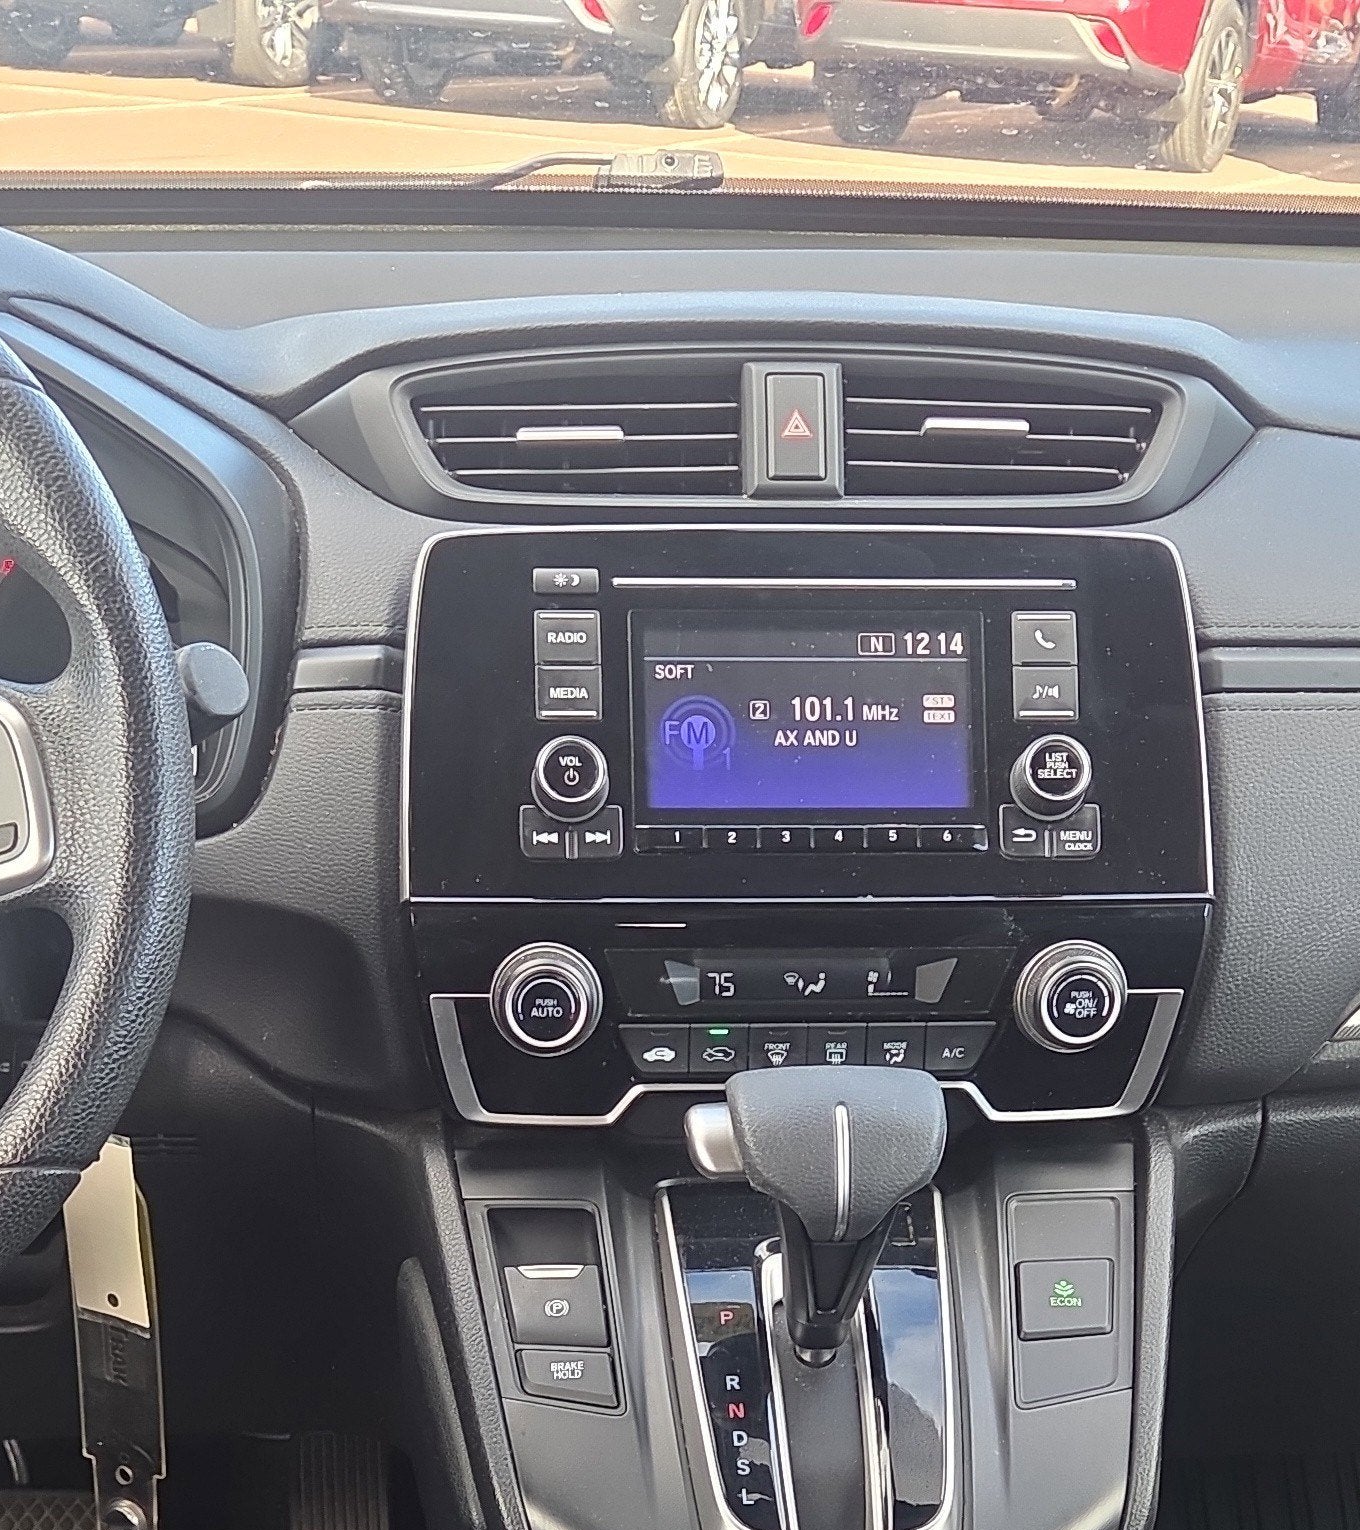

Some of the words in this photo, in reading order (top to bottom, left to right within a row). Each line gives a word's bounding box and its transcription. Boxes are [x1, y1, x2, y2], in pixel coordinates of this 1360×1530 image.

[547, 632, 587, 643] RADIO
[654, 664, 694, 679] SOFT
[549, 687, 589, 699] MEDIA
[791, 696, 854, 721] 101.1
[862, 705, 899, 721] MHz
[774, 730, 798, 747] AX
[803, 730, 840, 747] AND
[845, 730, 857, 747] U
[558, 756, 583, 767] VOL
[1045, 752, 1068, 762] LIST
[1037, 769, 1077, 779] SELECT
[674, 831, 680, 843] 1
[727, 831, 737, 843] 2
[781, 831, 791, 843] 3
[834, 830, 843, 842] 4
[890, 829, 898, 842] 5
[943, 829, 952, 842] 6
[1060, 831, 1093, 841] MENU
[1065, 842, 1094, 851] CLOCK
[706, 972, 735, 997] 75
[1070, 991, 1093, 999] PUSH
[535, 998, 557, 1007] PUSH
[1075, 998, 1099, 1009] ON/
[530, 1006, 563, 1018] AUTO
[1075, 1008, 1098, 1019] OFF
[763, 1042, 790, 1050] FRONT
[942, 1048, 965, 1059] A/C
[1049, 1296, 1082, 1307] ECON
[720, 1310, 734, 1325] P
[550, 1361, 584, 1372] BRAKE
[553, 1370, 582, 1380] HOLD
[725, 1375, 740, 1391] R
[728, 1402, 745, 1419] N
[733, 1430, 747, 1447] D
[736, 1458, 751, 1476] S
[741, 1488, 755, 1505] L
